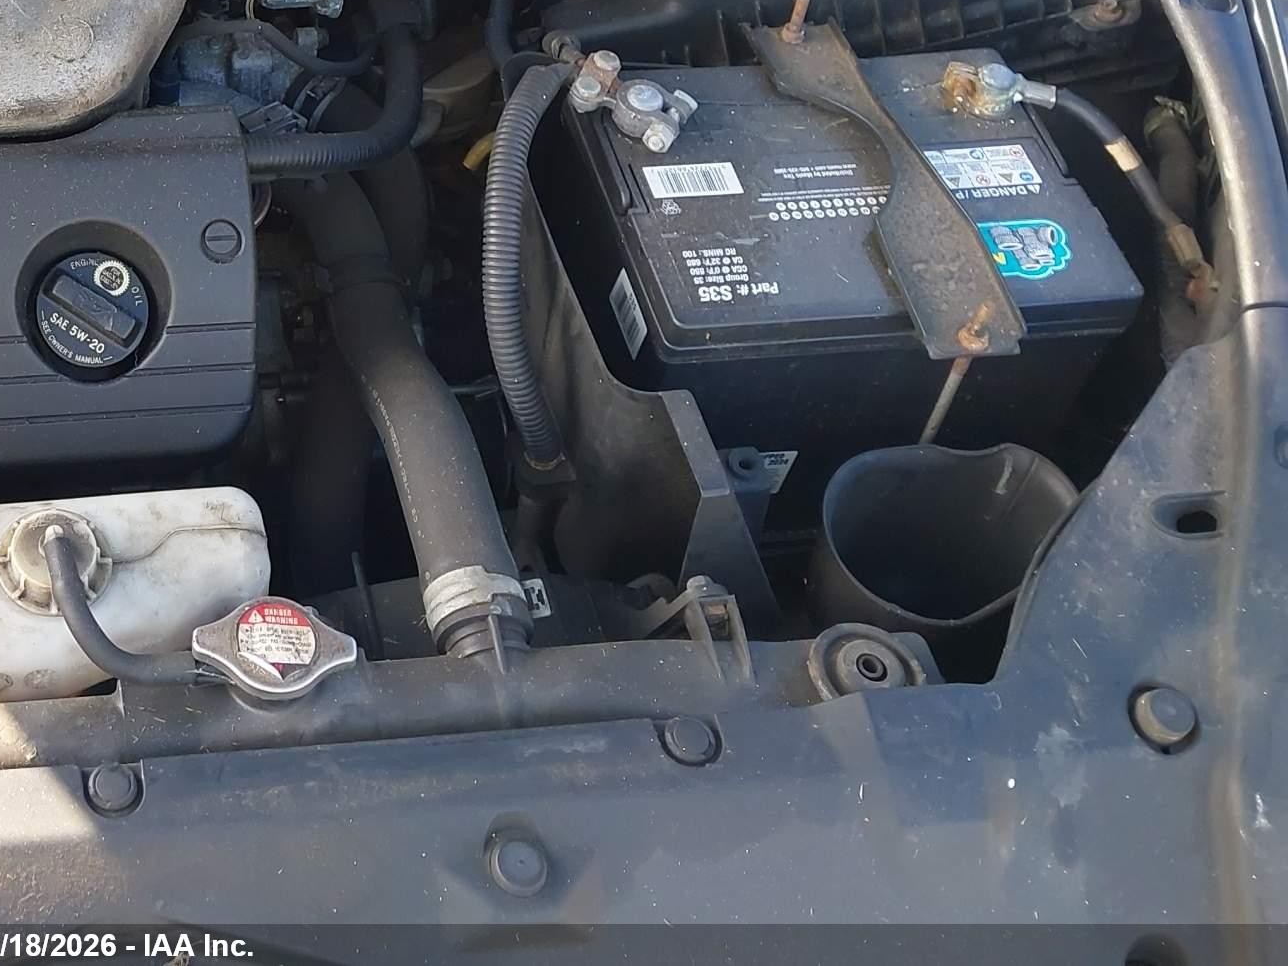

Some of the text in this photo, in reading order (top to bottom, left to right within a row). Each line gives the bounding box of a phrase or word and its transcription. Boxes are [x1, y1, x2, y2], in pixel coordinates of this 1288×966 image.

[971, 185, 1029, 199] DANGER
[732, 256, 743, 264] CA
[731, 264, 748, 272] CCA
[706, 275, 724, 283] Size:
[725, 274, 749, 282] Group
[698, 285, 733, 302] S35
[751, 282, 779, 295] Part
[131, 285, 144, 307] OIL
[49, 312, 105, 354] SAE 5W-20
[41, 320, 104, 365] SEE OWNER'S MANUAL
